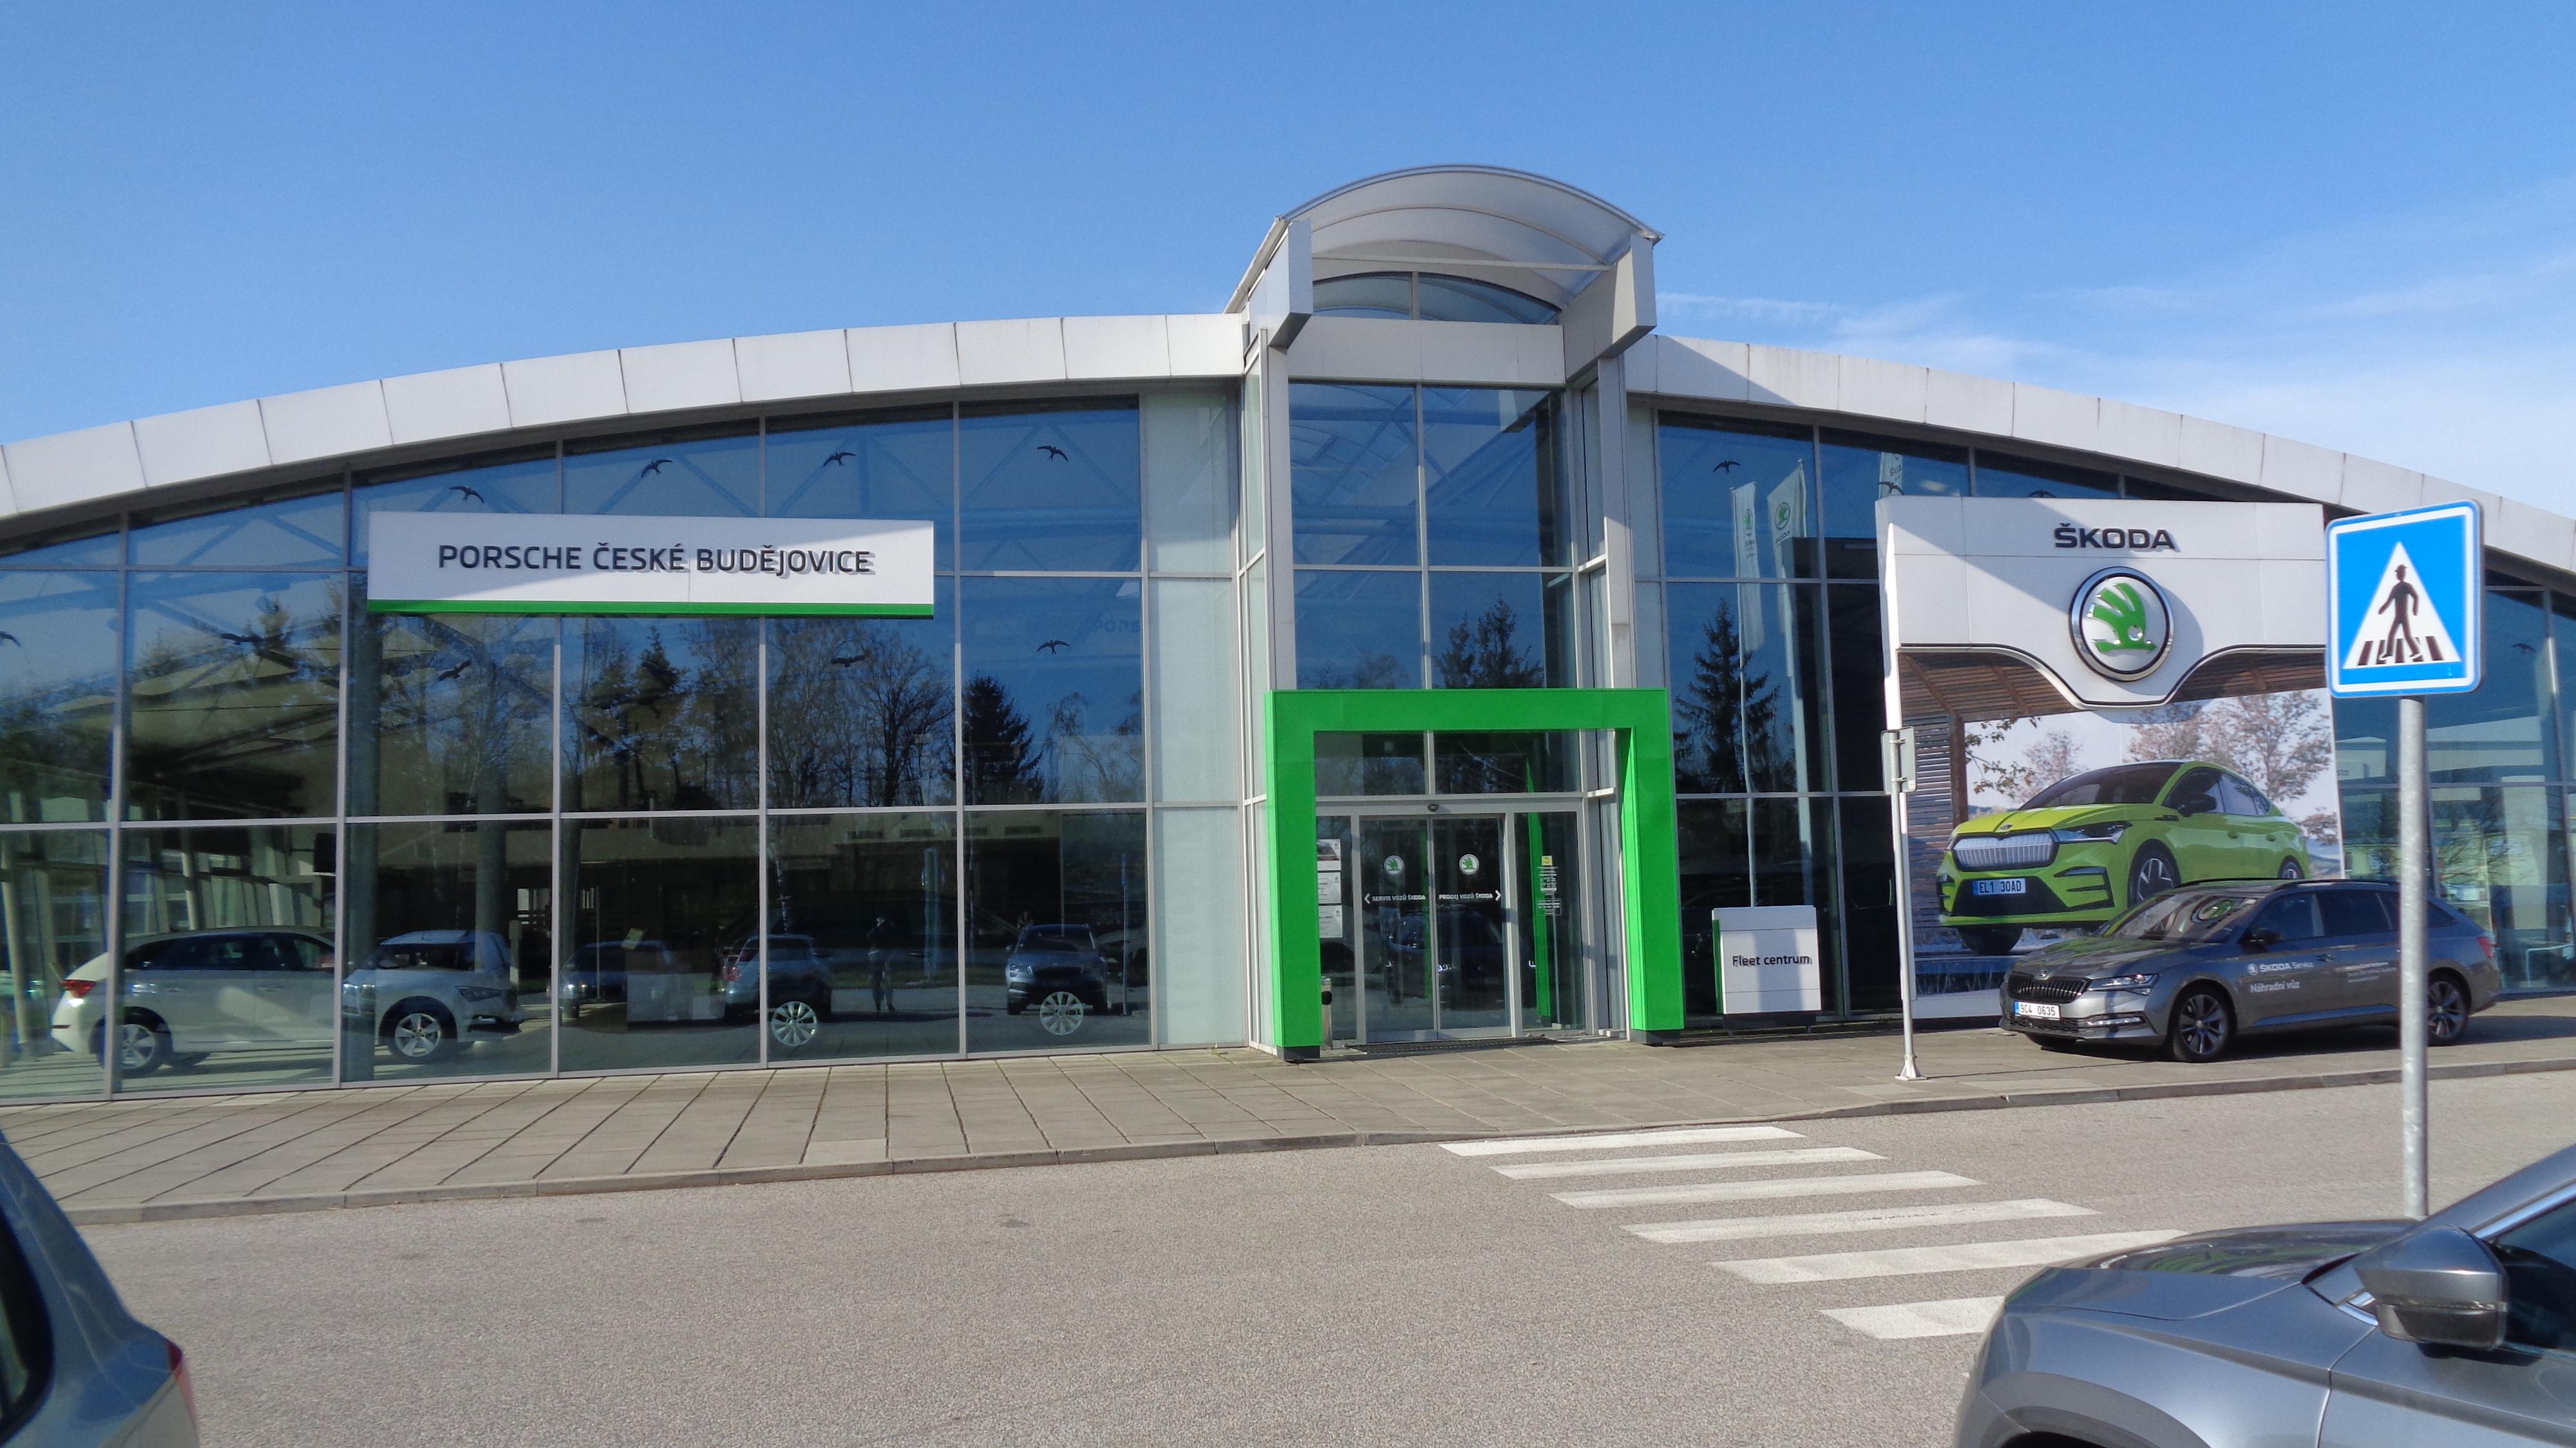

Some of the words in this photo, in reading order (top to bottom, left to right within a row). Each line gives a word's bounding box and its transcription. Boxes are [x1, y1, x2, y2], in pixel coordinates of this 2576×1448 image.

[2054, 523, 2175, 549] ŠKODA
[439, 545, 582, 569] PORSCHE
[593, 542, 685, 571] ČESKÉ
[697, 544, 870, 576] BUDĚJOVICE
[1980, 882, 1994, 893] EL1
[1732, 955, 1761, 966] Fleet
[1764, 955, 1810, 965] centrum
[2259, 962, 2291, 972] ŠKODA
[2020, 1004, 2032, 1013] 9C4
[2038, 1005, 2056, 1016] 0635
